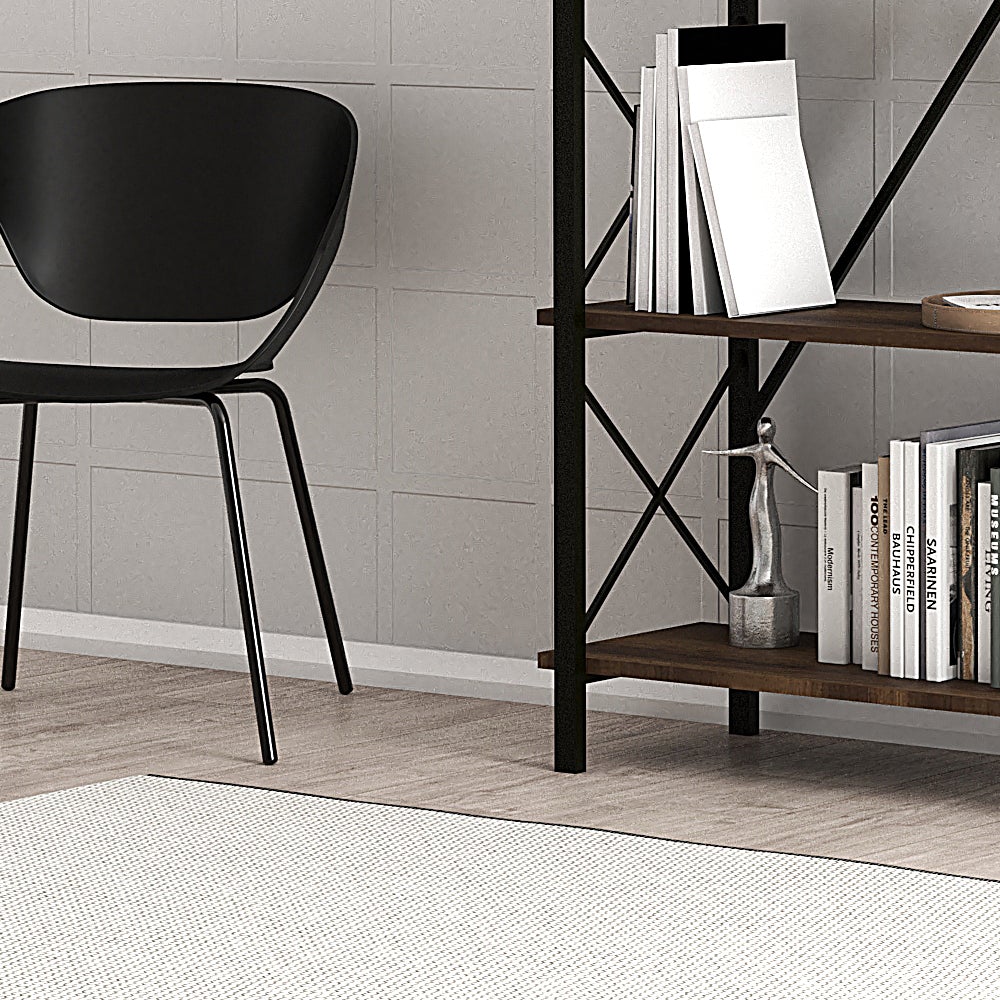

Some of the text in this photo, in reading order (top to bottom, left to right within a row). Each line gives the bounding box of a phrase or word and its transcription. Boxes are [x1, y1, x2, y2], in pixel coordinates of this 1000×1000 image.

[892, 533, 901, 595] BAUHAUS
[906, 525, 915, 613] CHIPPERFIELD
[990, 494, 999, 576] MUSEUMS
[926, 538, 937, 610] SAARINEN
[870, 611, 879, 653] HOUSES
